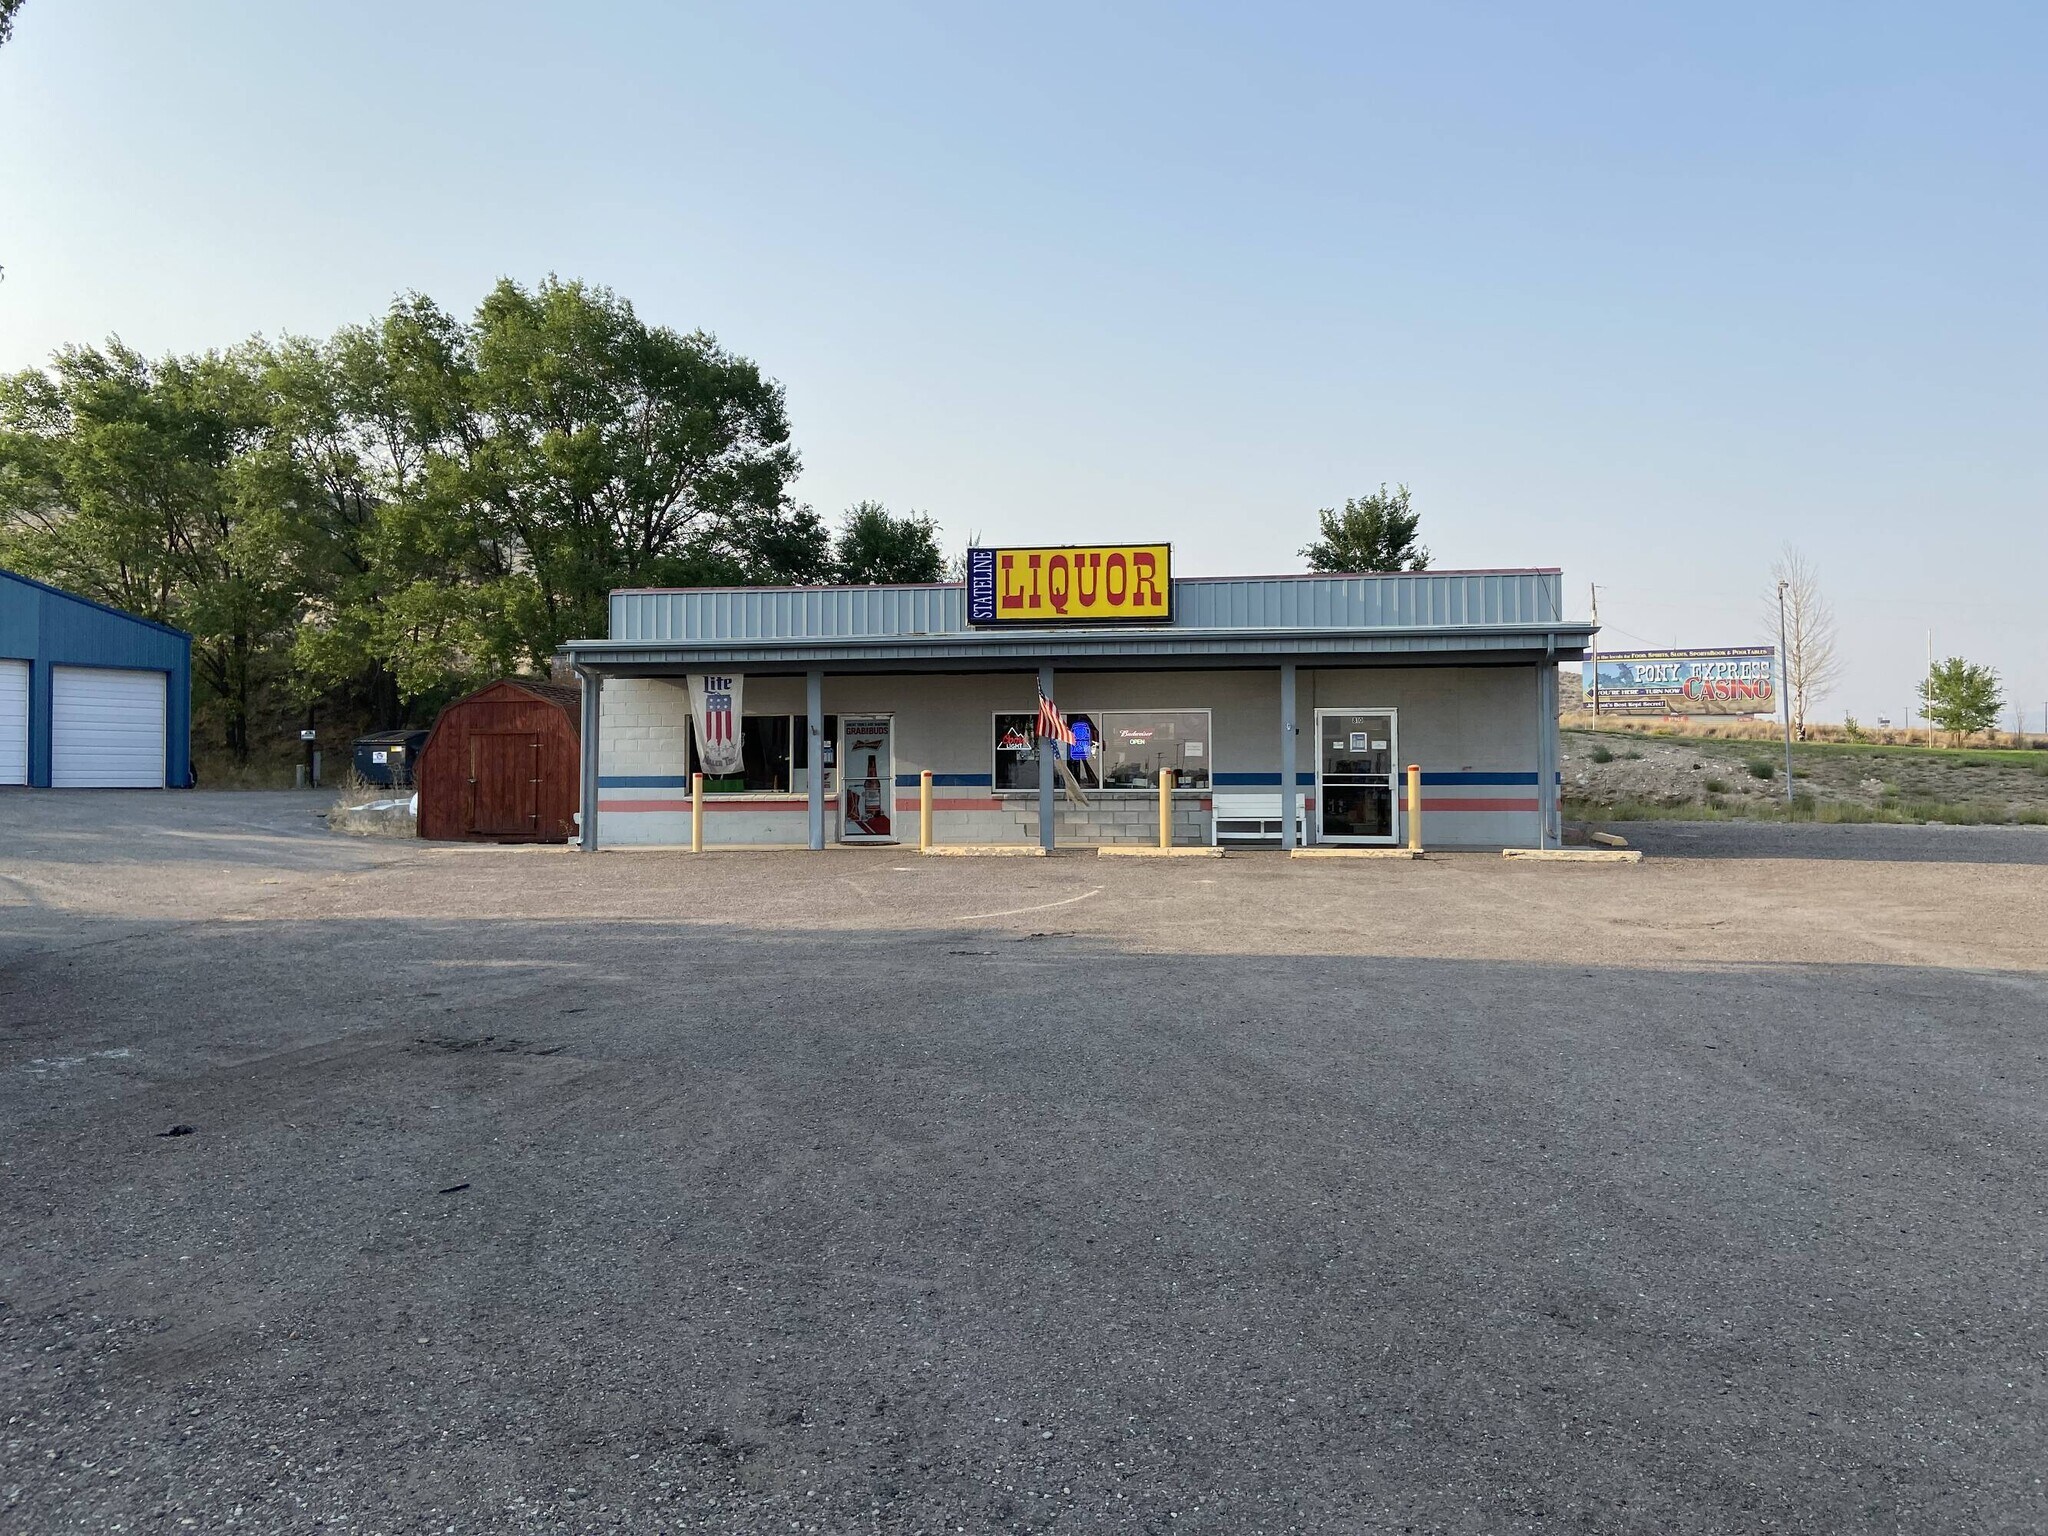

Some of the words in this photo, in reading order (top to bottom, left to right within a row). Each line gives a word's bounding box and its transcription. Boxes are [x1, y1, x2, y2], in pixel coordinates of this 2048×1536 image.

[973, 551, 993, 618] STATELINE
[1001, 552, 1162, 615] LIQUOR
[1634, 663, 1681, 683] PONY
[1690, 661, 1771, 680] EXPRESS
[703, 675, 732, 694] Lite
[1683, 677, 1772, 702] CASINO
[1119, 729, 1153, 737] Budweiser
